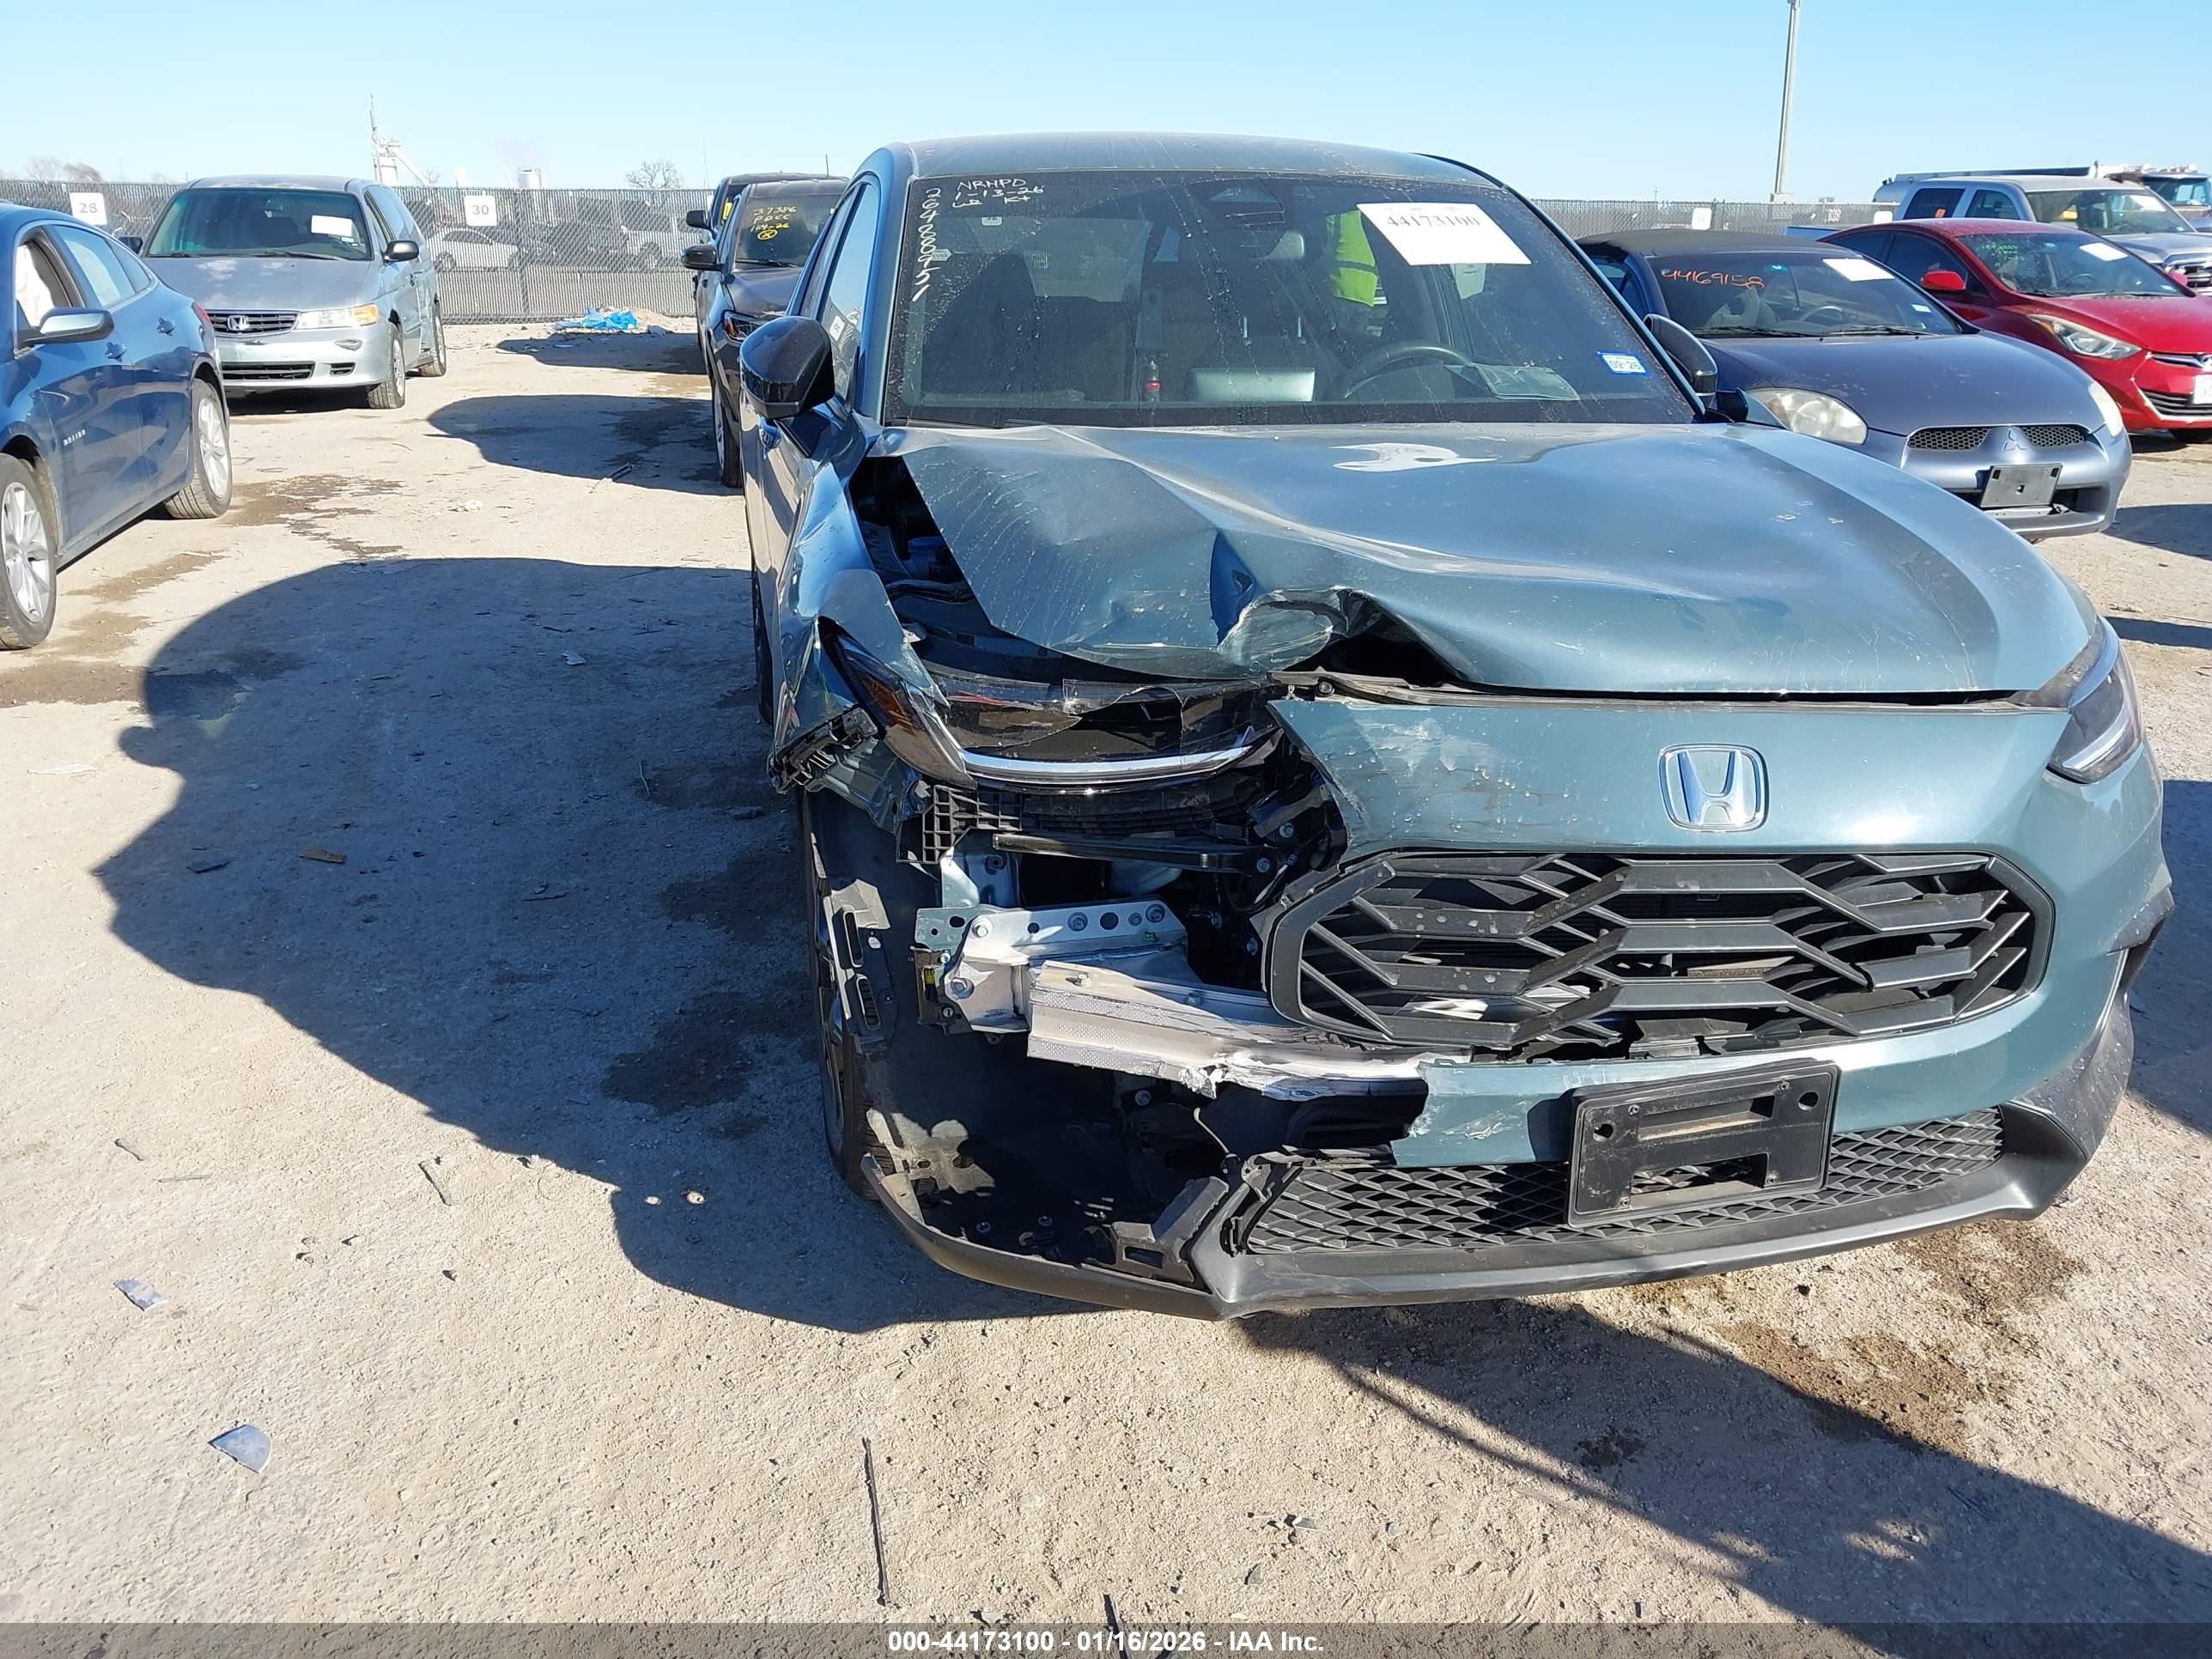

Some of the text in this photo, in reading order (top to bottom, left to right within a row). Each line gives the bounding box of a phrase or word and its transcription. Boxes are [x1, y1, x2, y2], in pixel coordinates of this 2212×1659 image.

[957, 179, 1027, 191] NRHPD
[79, 203, 98, 214] 28
[472, 204, 489, 215] 30
[1387, 216, 1480, 227] 44173100
[1661, 269, 1765, 289] 44169158
